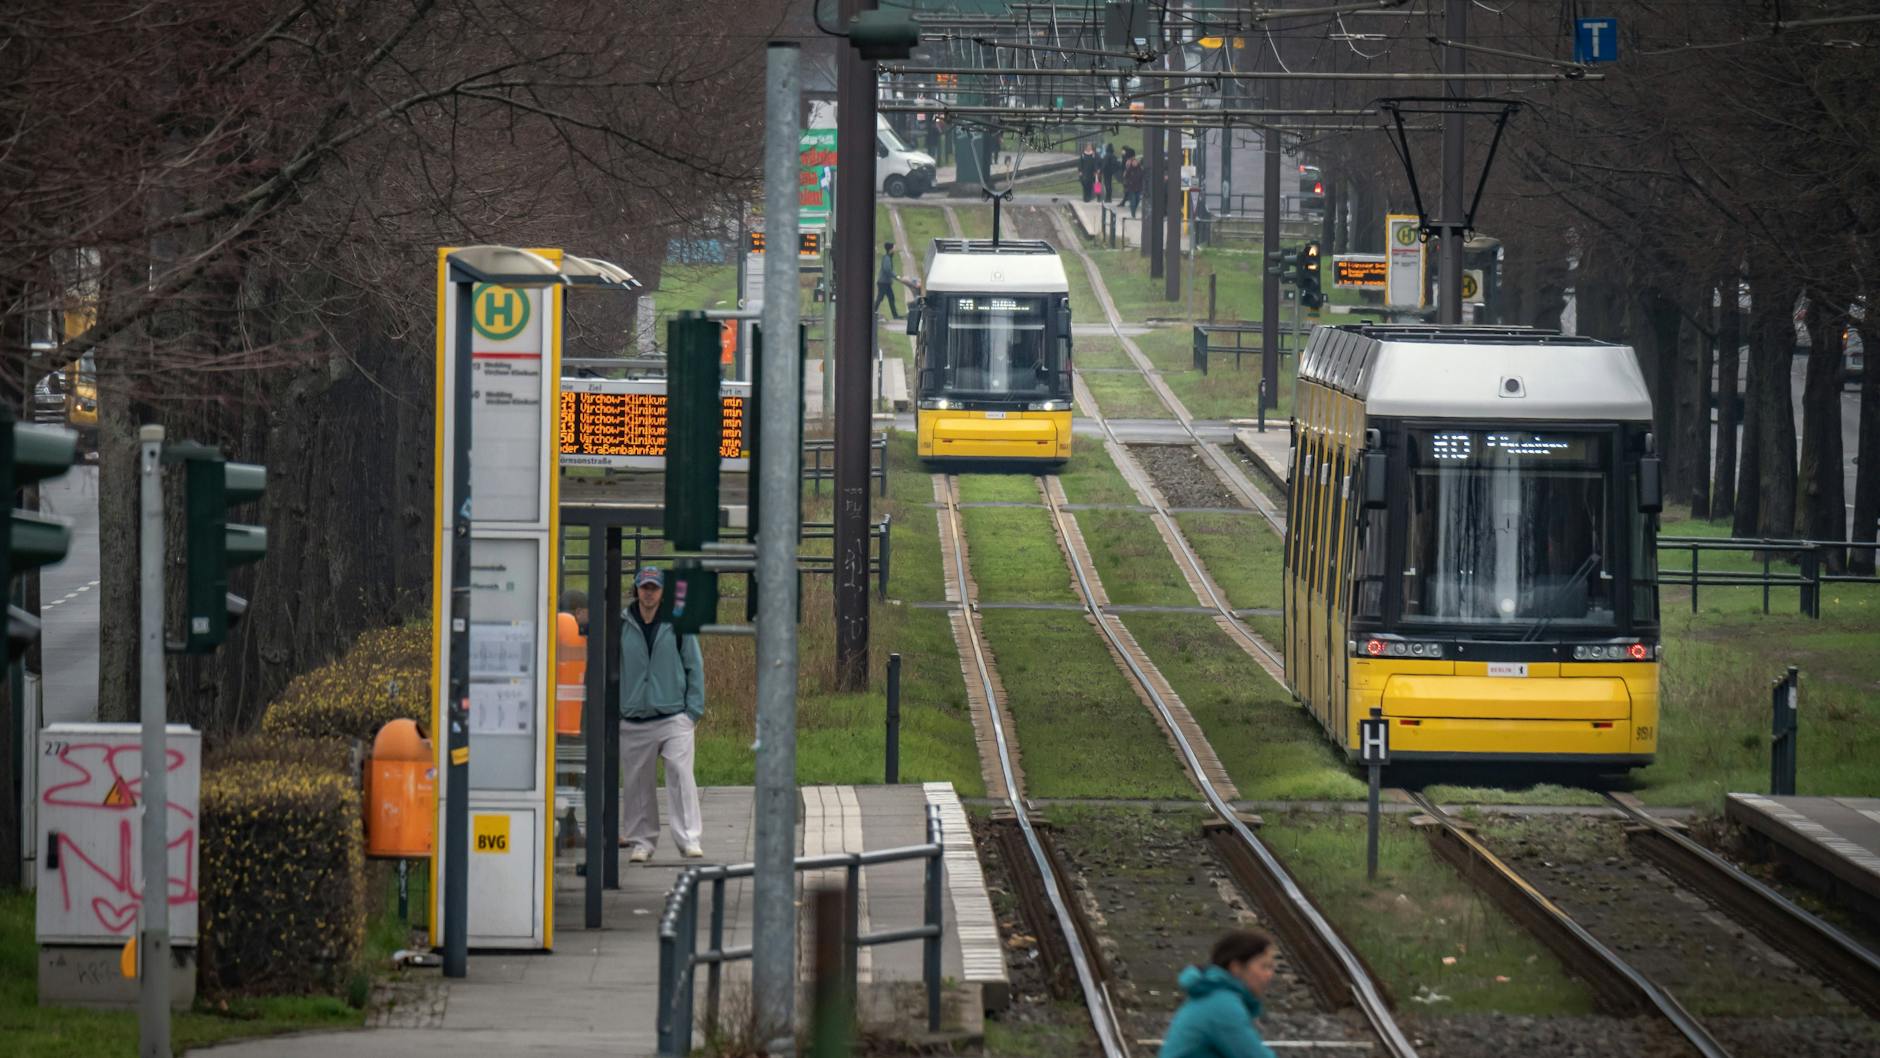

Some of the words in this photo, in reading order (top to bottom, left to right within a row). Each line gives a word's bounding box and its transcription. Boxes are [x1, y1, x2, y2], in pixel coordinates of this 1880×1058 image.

[1583, 22, 1608, 57] T
[485, 293, 513, 326] H
[723, 397, 742, 407] min
[723, 407, 742, 417] min
[723, 417, 742, 427] min
[723, 428, 742, 437] min
[723, 438, 742, 447] min
[1363, 723, 1385, 759] H
[478, 834, 506, 850] BVG
